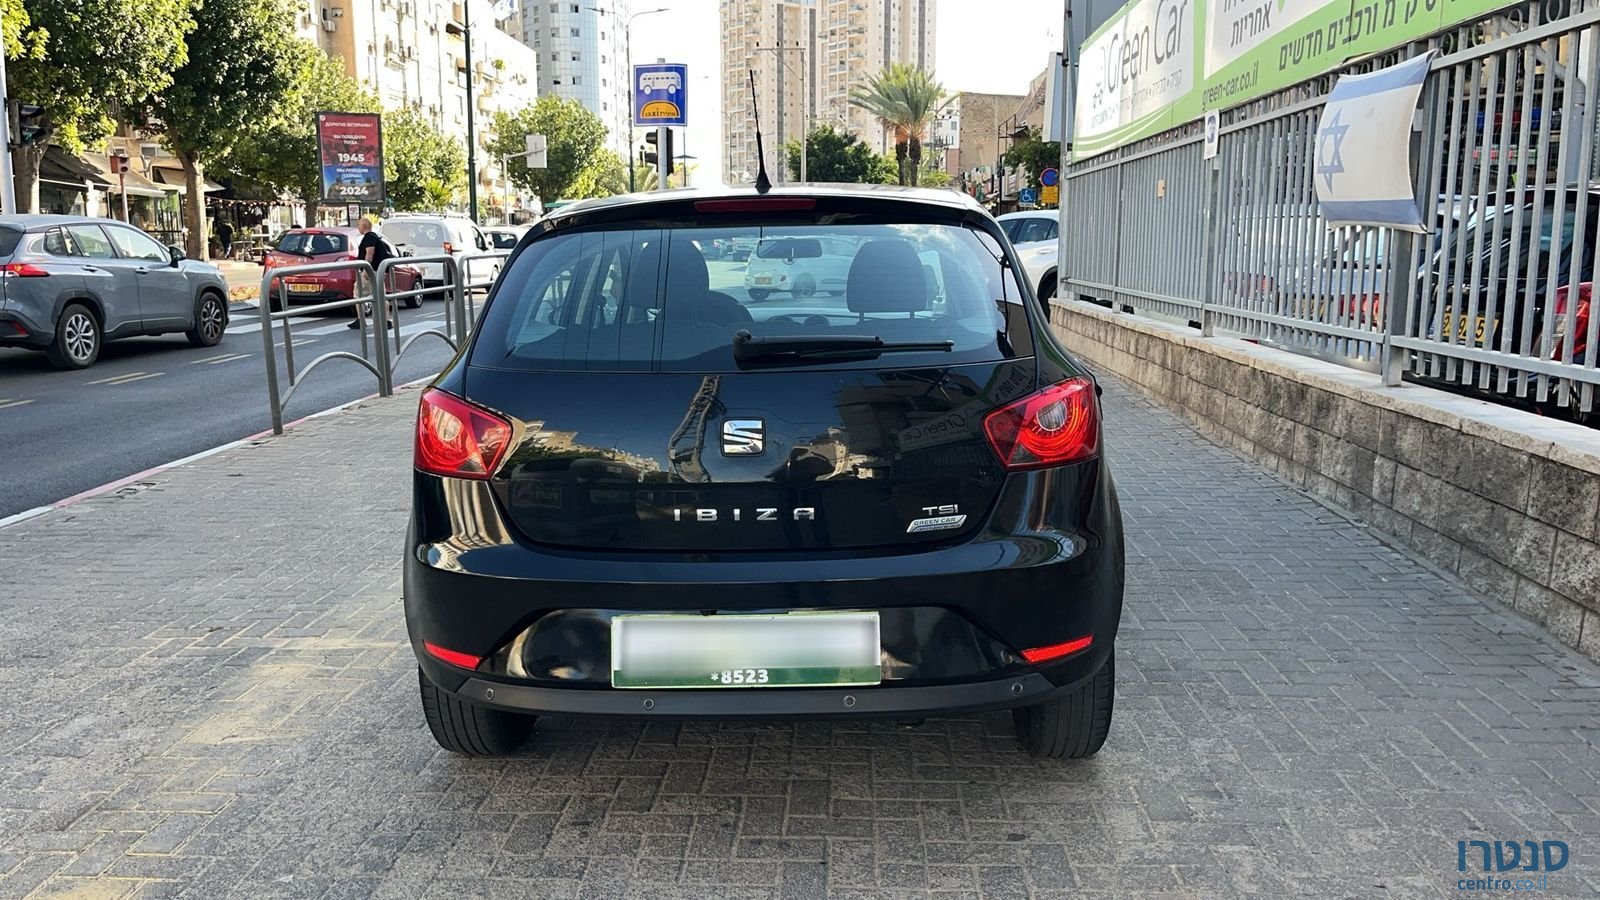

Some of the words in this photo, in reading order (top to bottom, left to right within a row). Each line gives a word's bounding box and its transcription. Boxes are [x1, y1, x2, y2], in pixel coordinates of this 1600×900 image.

[1231, 0, 1272, 48] אחריות
[1327, 2, 1379, 51] ורכבים
[1107, 25, 1150, 93] Green
[1154, 0, 1187, 64] Car
[1279, 29, 1323, 71] חדשים
[1202, 60, 1259, 112] green-car.co.il
[338, 153, 365, 162] 1945
[340, 186, 369, 195] 2024
[673, 507, 815, 522] IBIZA
[922, 504, 958, 515] TSI
